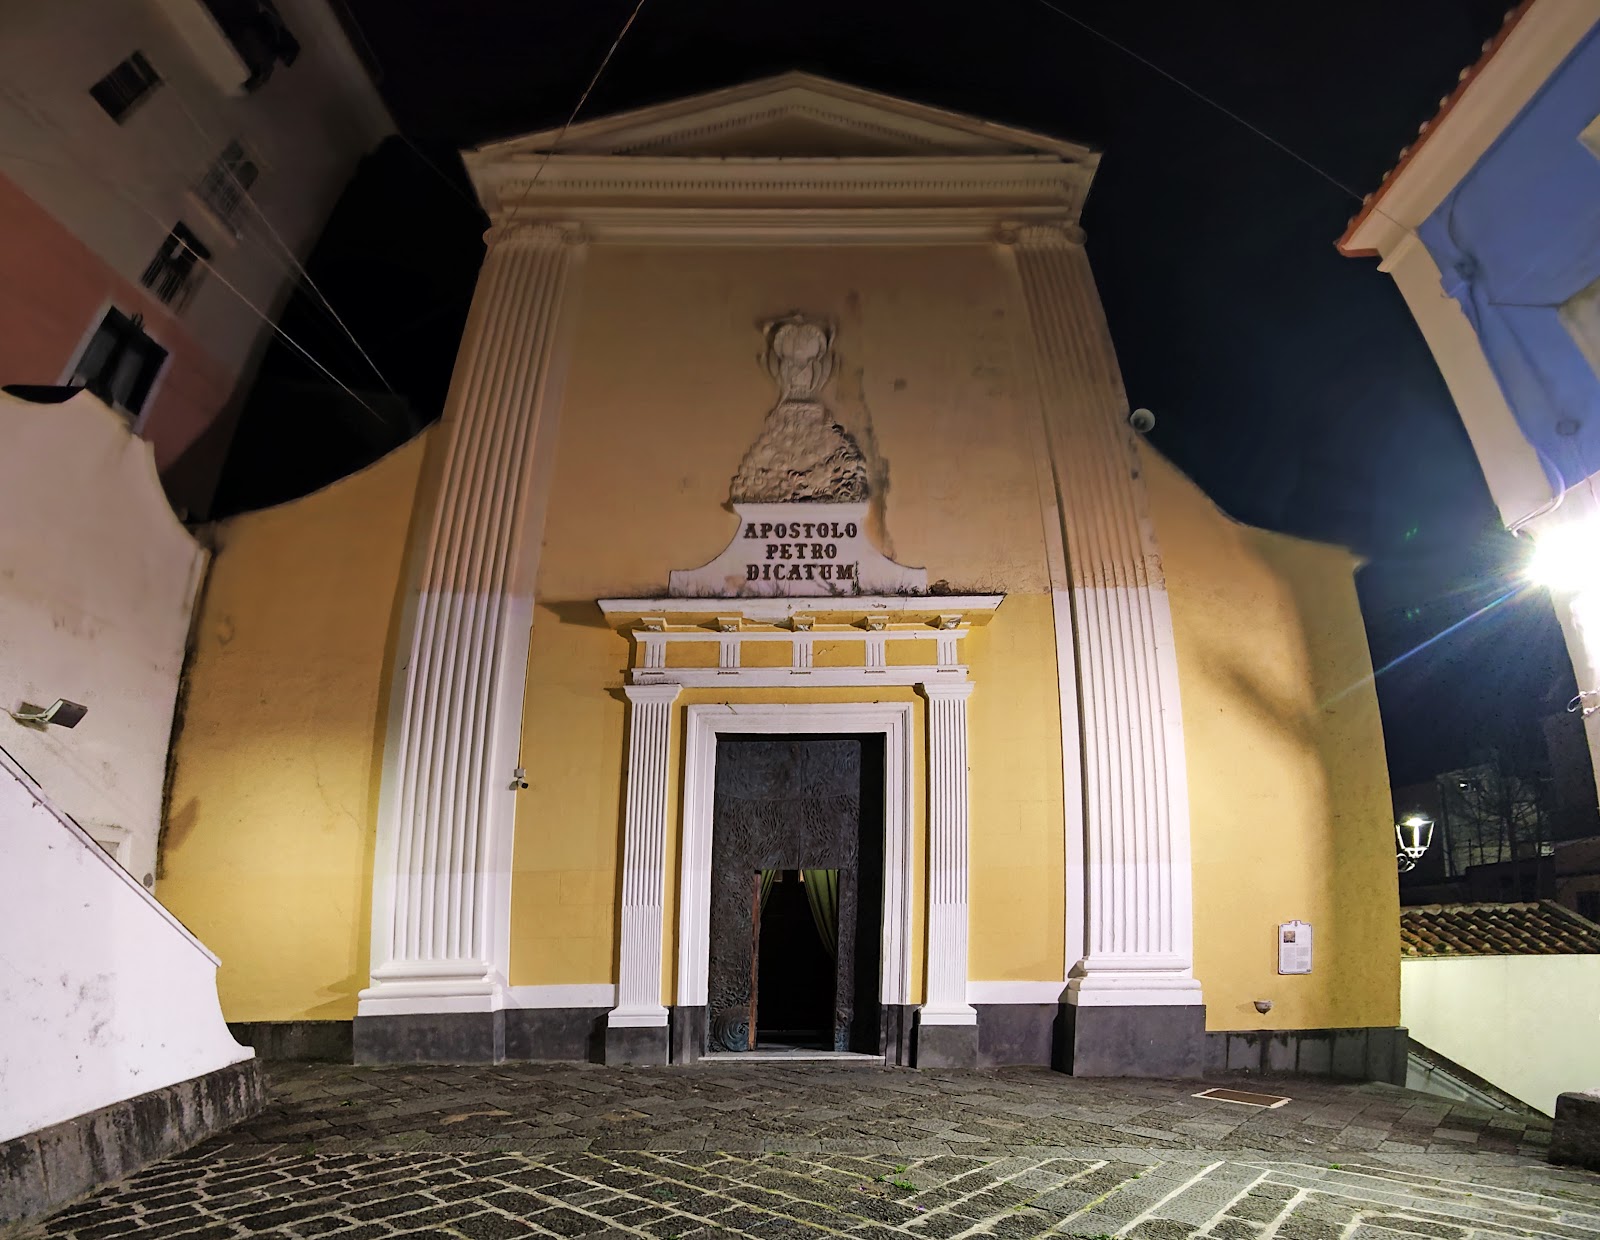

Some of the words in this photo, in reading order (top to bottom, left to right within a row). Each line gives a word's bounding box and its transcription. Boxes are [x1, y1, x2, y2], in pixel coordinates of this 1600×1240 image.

[743, 522, 858, 539] APOSTOLO
[766, 543, 838, 560] PETRO
[746, 564, 855, 581] DICATUM
